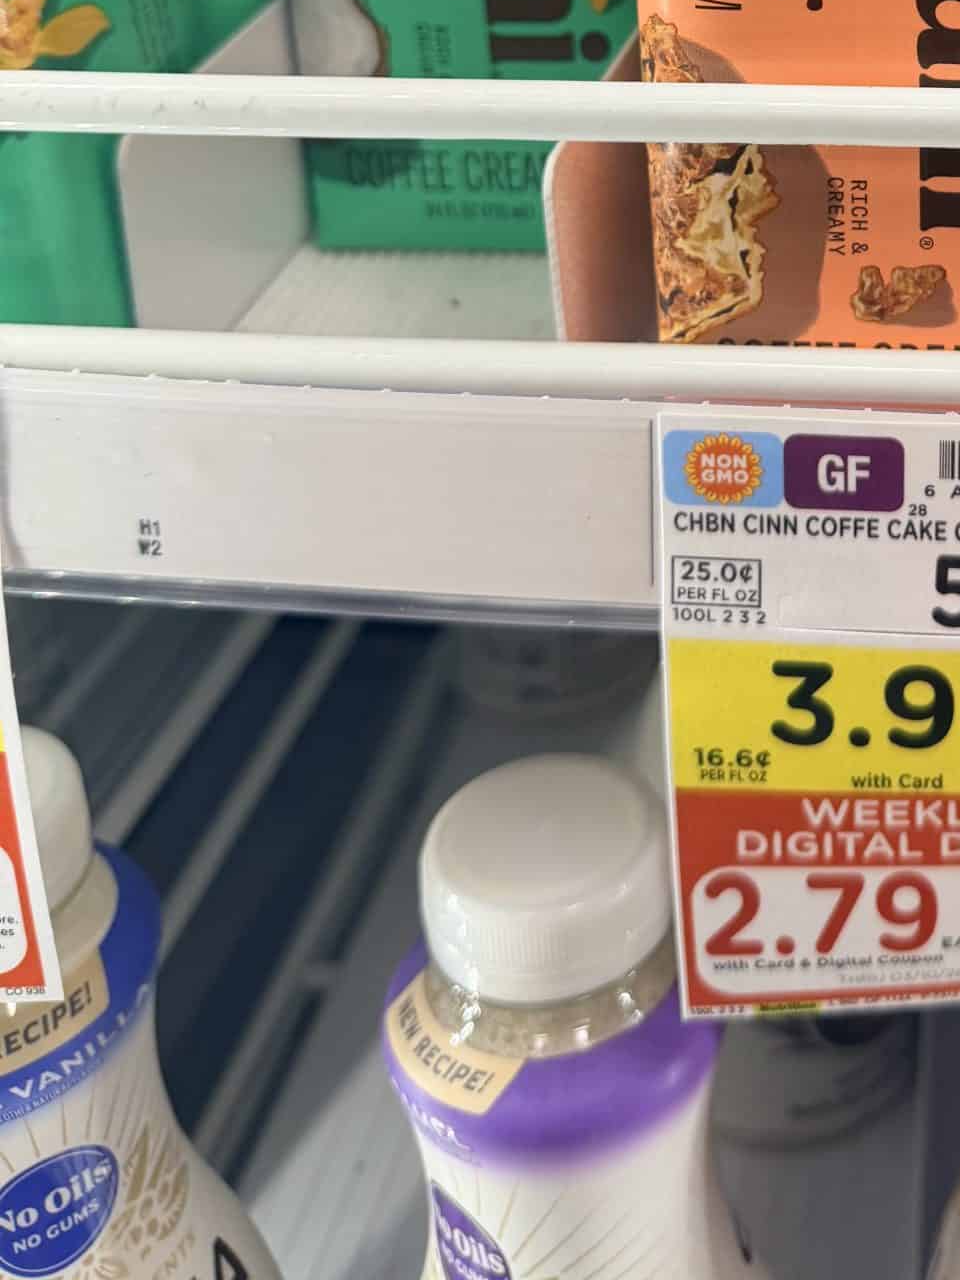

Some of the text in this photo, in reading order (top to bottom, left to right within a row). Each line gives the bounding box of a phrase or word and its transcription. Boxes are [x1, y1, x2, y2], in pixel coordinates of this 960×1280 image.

[464, 149, 548, 194] CREA
[827, 177, 845, 256] CREAMY
[851, 179, 869, 255] RICH &
[701, 453, 748, 468] NON
[817, 453, 871, 495] GF
[701, 470, 749, 485] GMO
[924, 484, 936, 498] 6
[908, 503, 927, 517] 28
[673, 511, 736, 534] CHBN
[743, 513, 799, 536] CINN
[805, 516, 880, 539] COFFE
[887, 518, 947, 542] CAKE
[681, 560, 754, 584] 25.0¢
[677, 585, 759, 602] PER FL OZ
[722, 609, 734, 623] 2
[739, 609, 751, 624] 3
[755, 610, 768, 625] 2
[700, 768, 726, 782] PER
[851, 772, 944, 790] with Card
[736, 829, 924, 860] DIGITAL
[704, 870, 939, 957] 2.79
[0, 980, 93, 1059] ECIPE!
[412, 1034, 496, 1095] RECIPE!
[44, 1157, 113, 1214] Oils
[12, 1197, 100, 1255] NO GUMS
